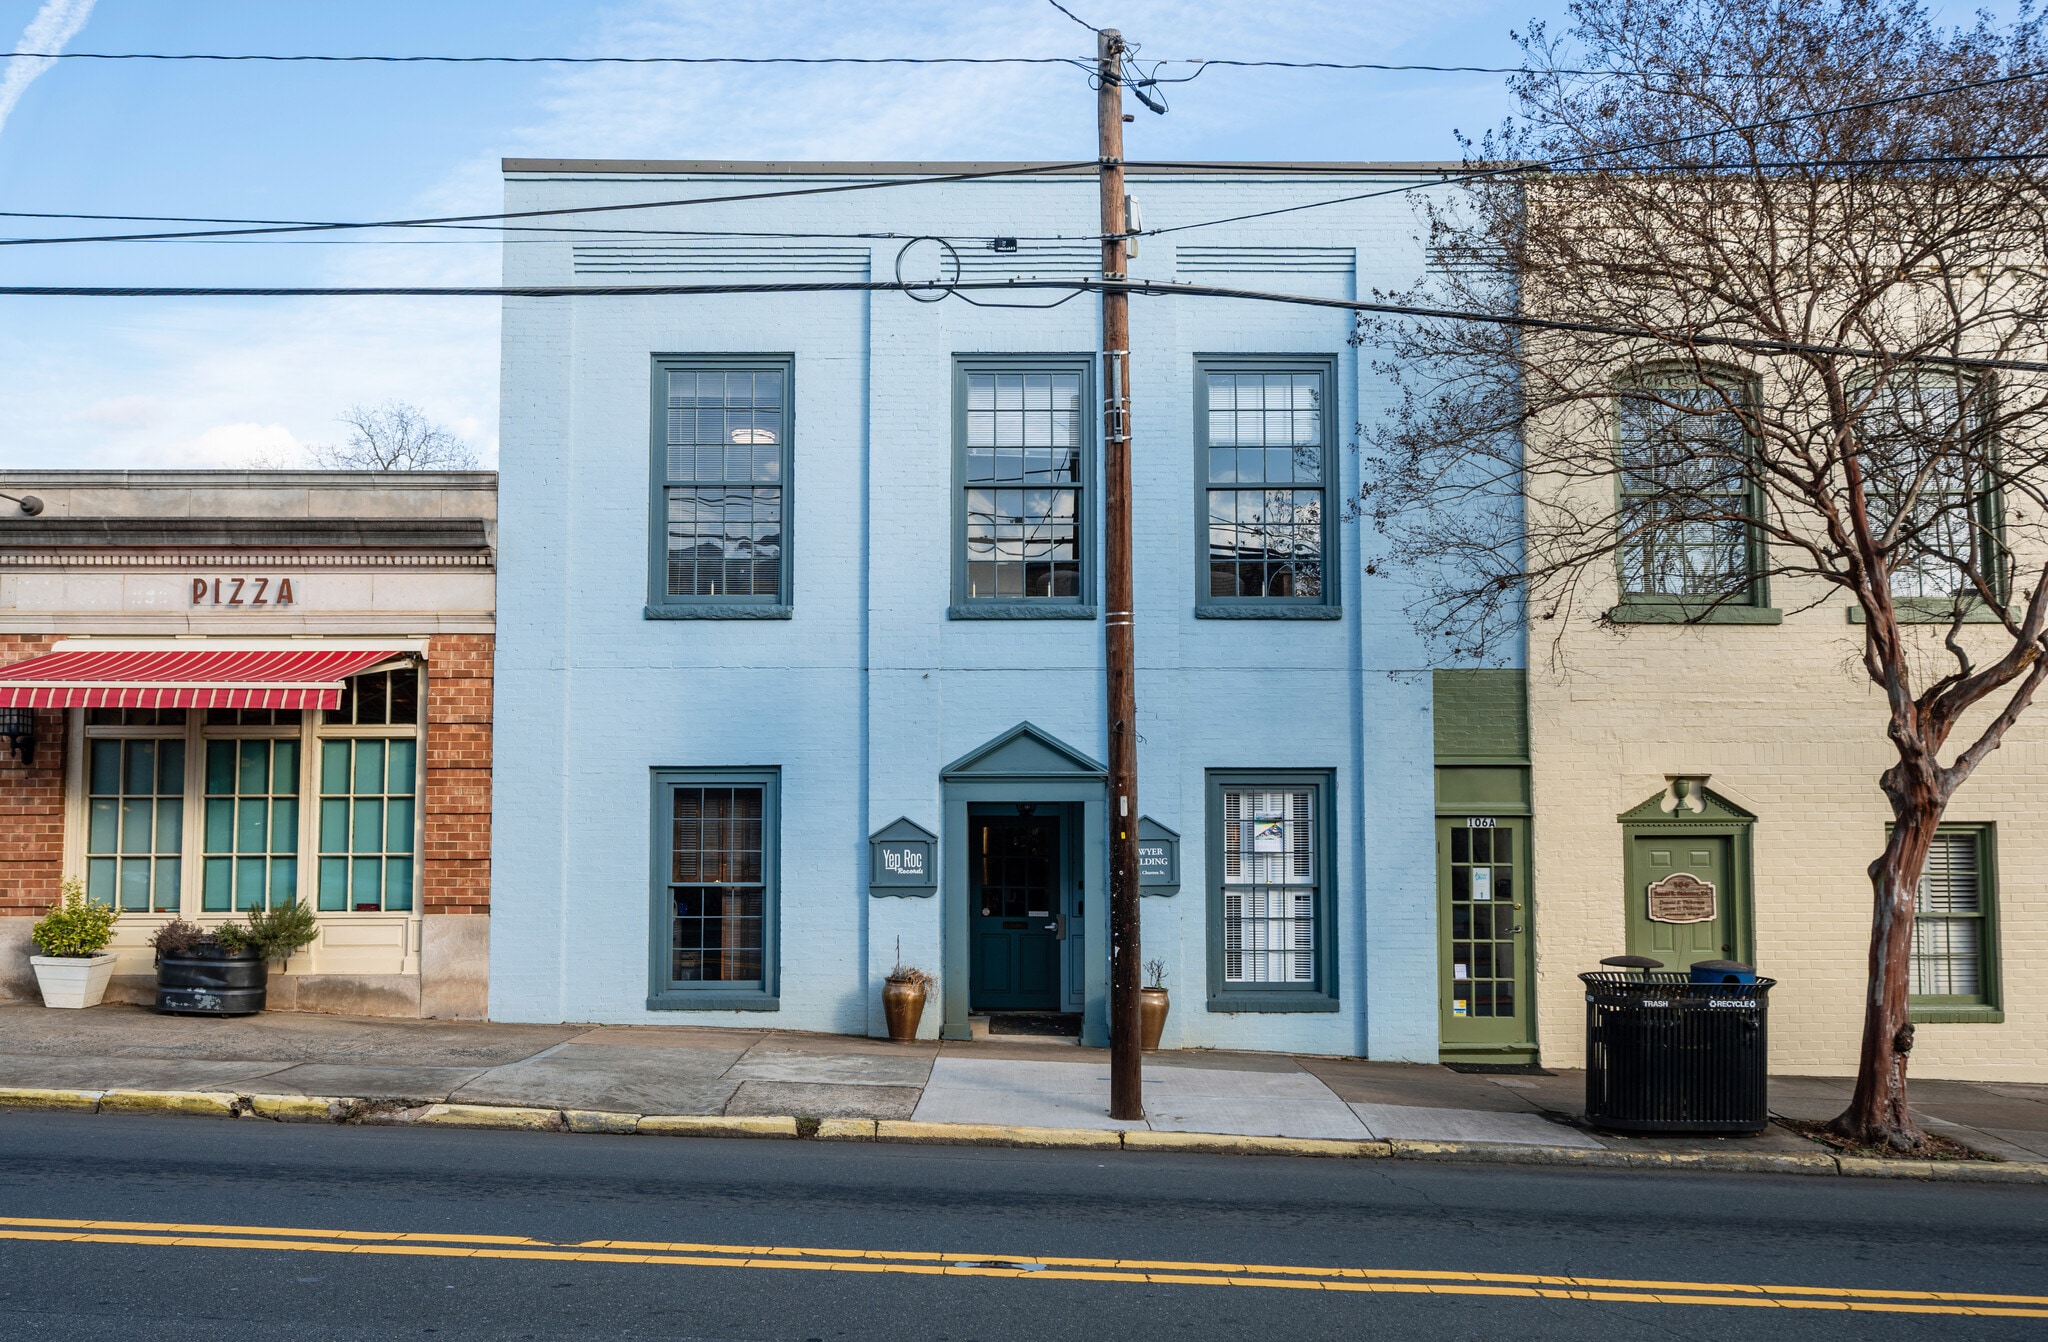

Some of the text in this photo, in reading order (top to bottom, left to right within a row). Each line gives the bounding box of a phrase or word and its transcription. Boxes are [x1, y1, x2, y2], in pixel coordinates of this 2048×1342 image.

[193, 578, 293, 604] PIZZA
[1469, 818, 1495, 827] 106A
[883, 849, 922, 871] Yep Roc
